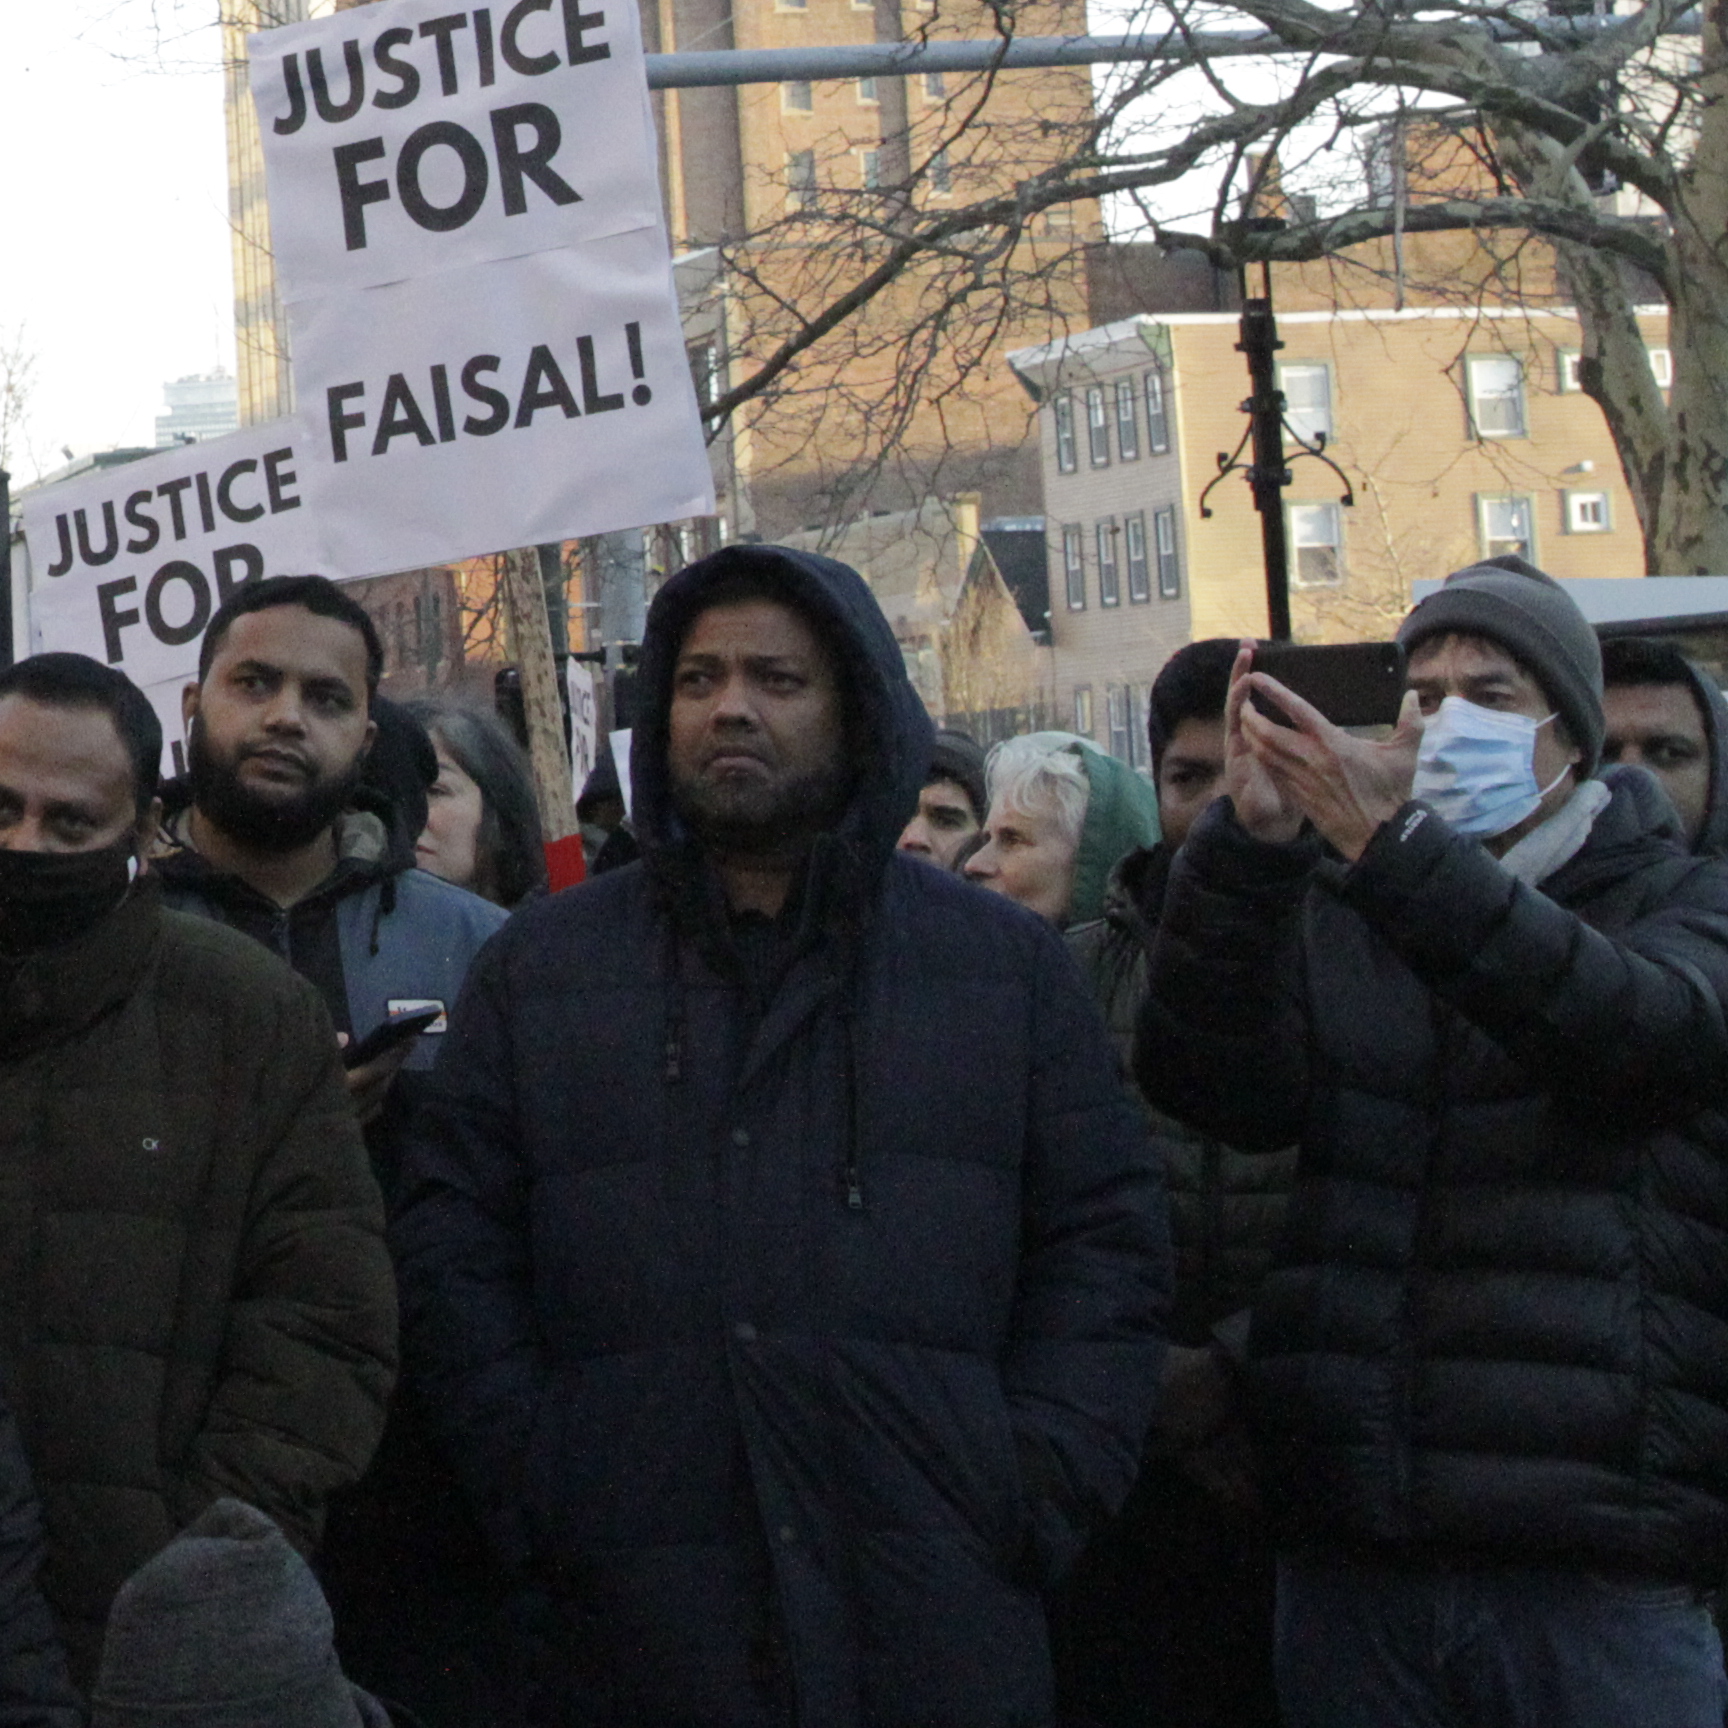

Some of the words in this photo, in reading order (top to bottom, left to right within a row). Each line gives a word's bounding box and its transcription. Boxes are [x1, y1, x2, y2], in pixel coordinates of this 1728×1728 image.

[333, 102, 583, 251] FOR
[326, 321, 652, 463] FAISAL!
[47, 446, 302, 578] JUSTICE
